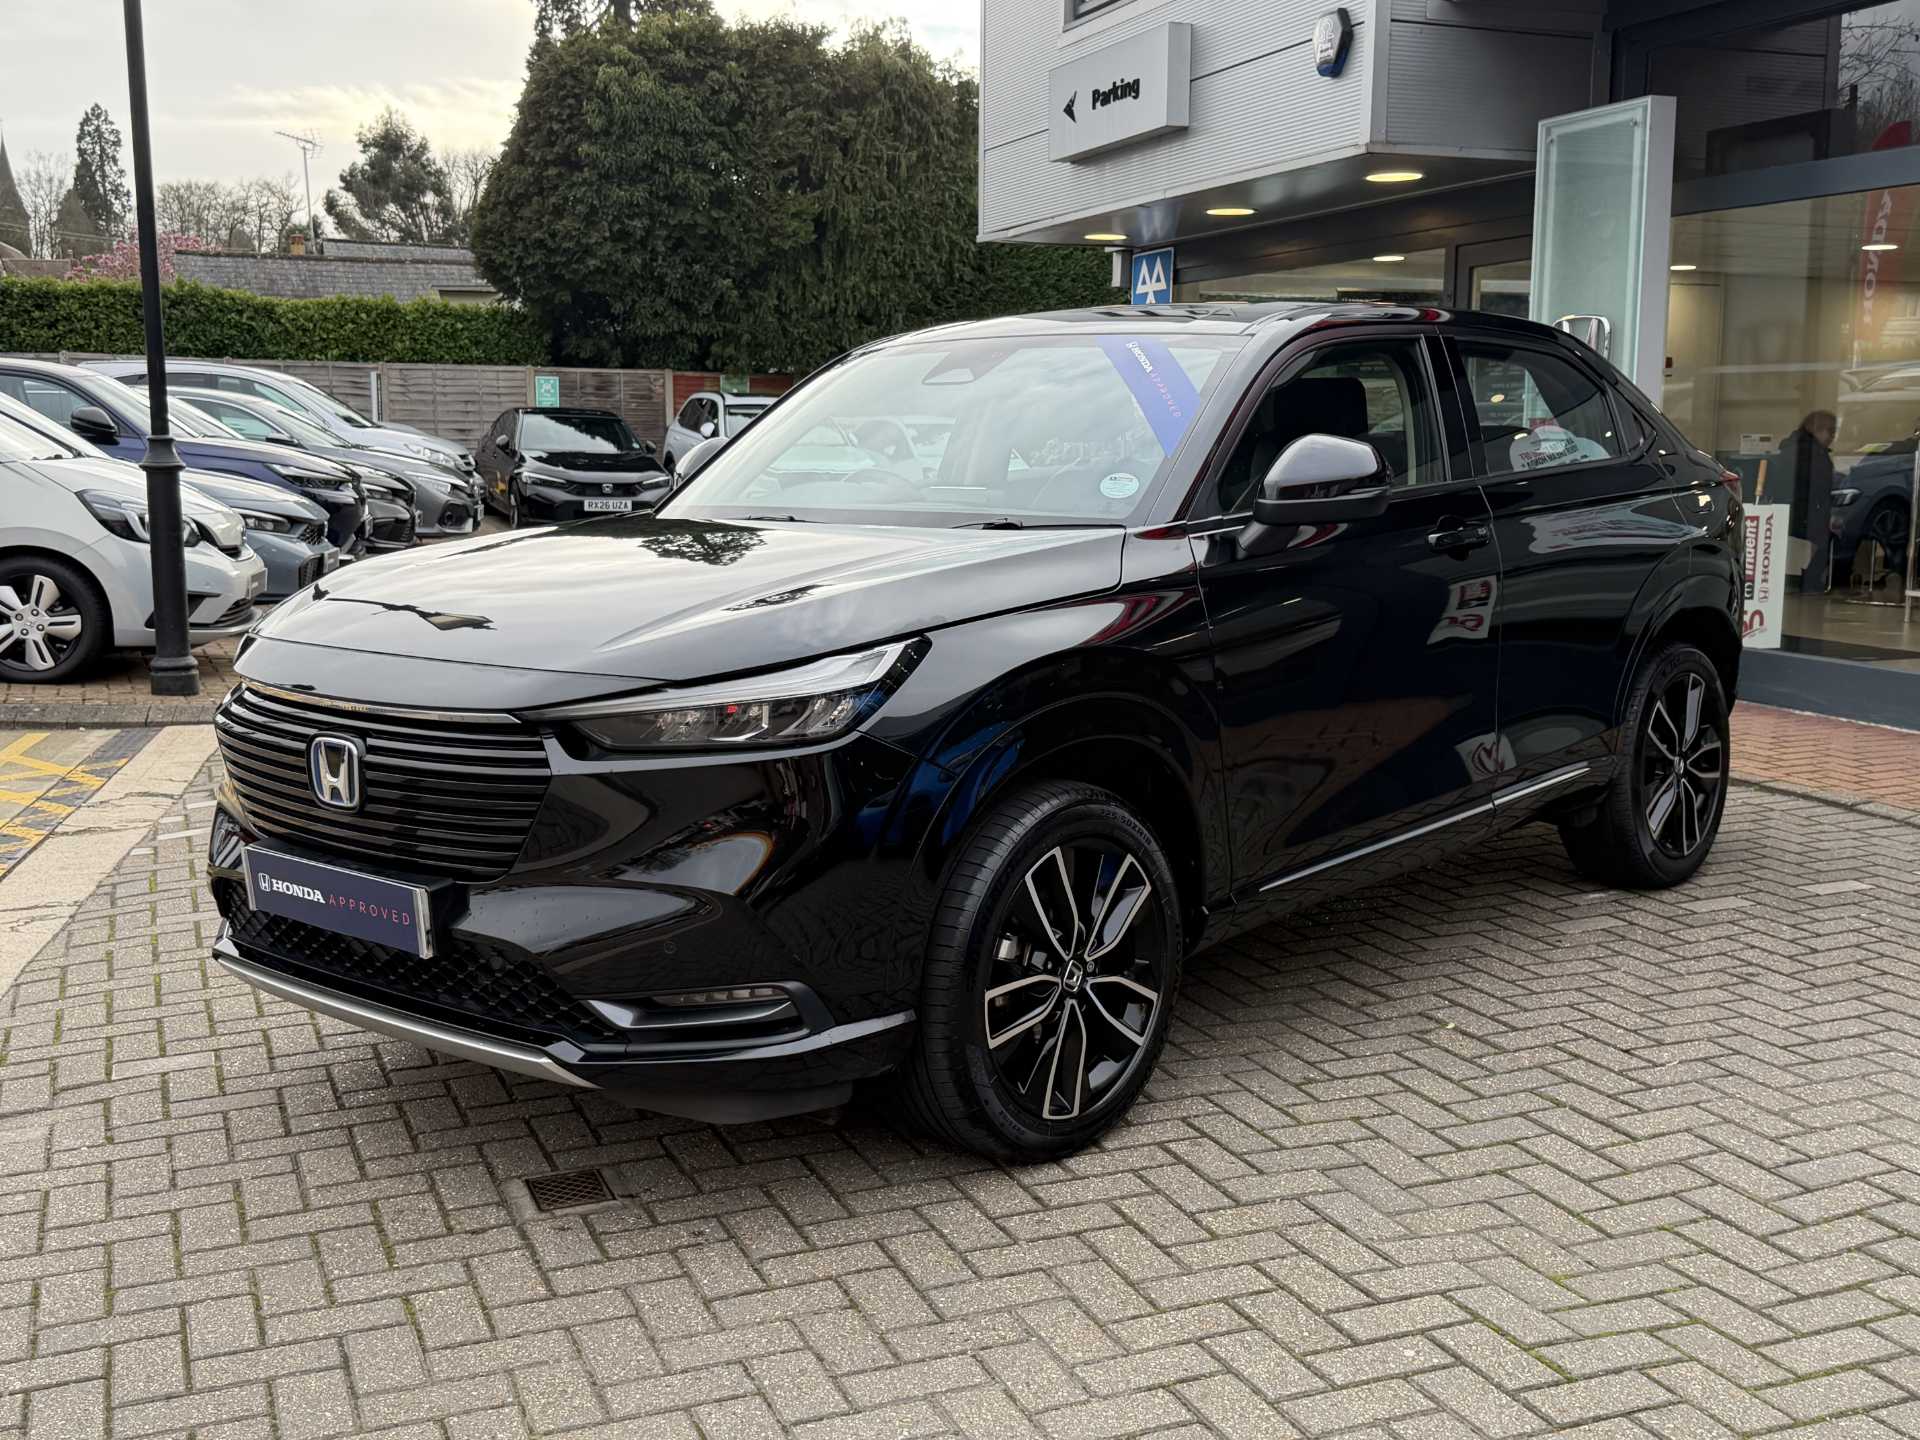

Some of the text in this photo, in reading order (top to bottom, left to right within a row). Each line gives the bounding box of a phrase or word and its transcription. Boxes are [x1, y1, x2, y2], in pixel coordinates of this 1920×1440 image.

[1091, 77, 1140, 110] Parking
[1130, 345, 1153, 373] HONDA
[588, 501, 628, 510] RX26 UZA
[1761, 512, 1774, 584] HONDA
[271, 877, 410, 926] HONDA APPROVED
